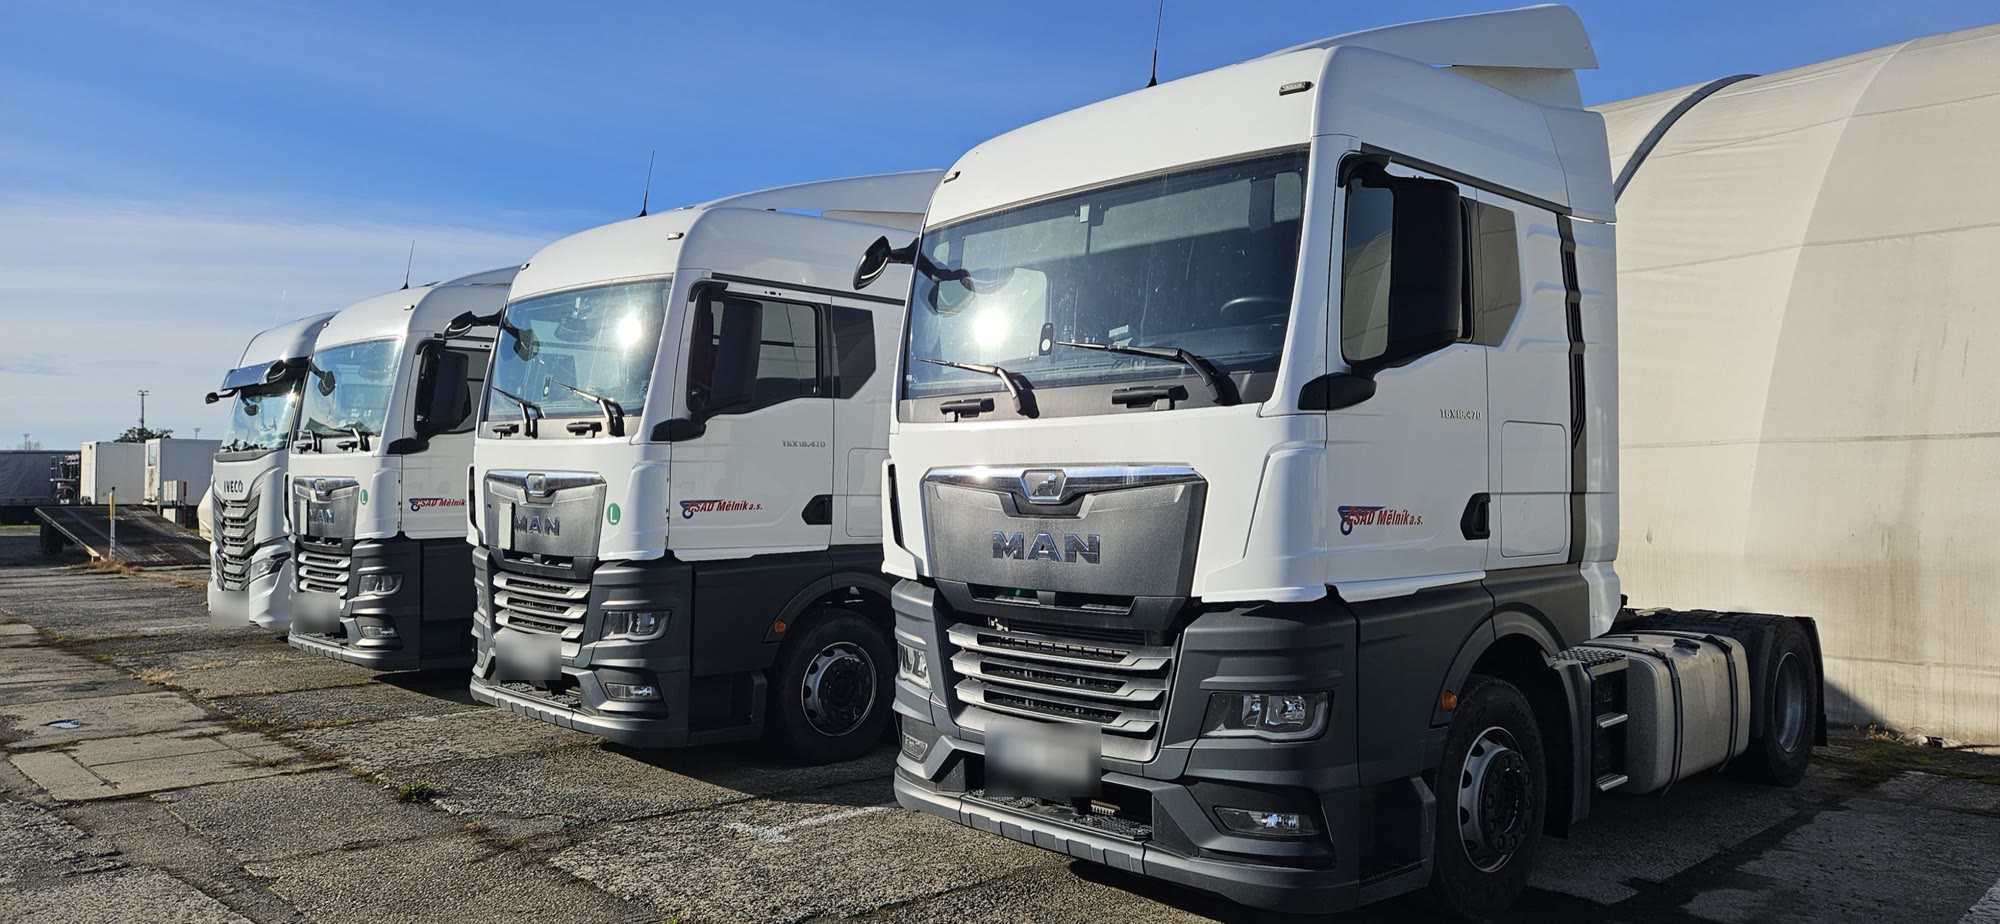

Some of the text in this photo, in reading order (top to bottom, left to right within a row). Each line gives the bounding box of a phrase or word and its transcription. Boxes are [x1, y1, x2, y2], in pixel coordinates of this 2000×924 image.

[223, 480, 243, 493] IVECO
[716, 500, 748, 511] Mělník
[748, 503, 763, 511] a.s.
[513, 515, 559, 536] MAN
[1376, 509, 1410, 526] Mělník
[1409, 515, 1424, 526] a.s.
[992, 530, 1100, 565] MAN
